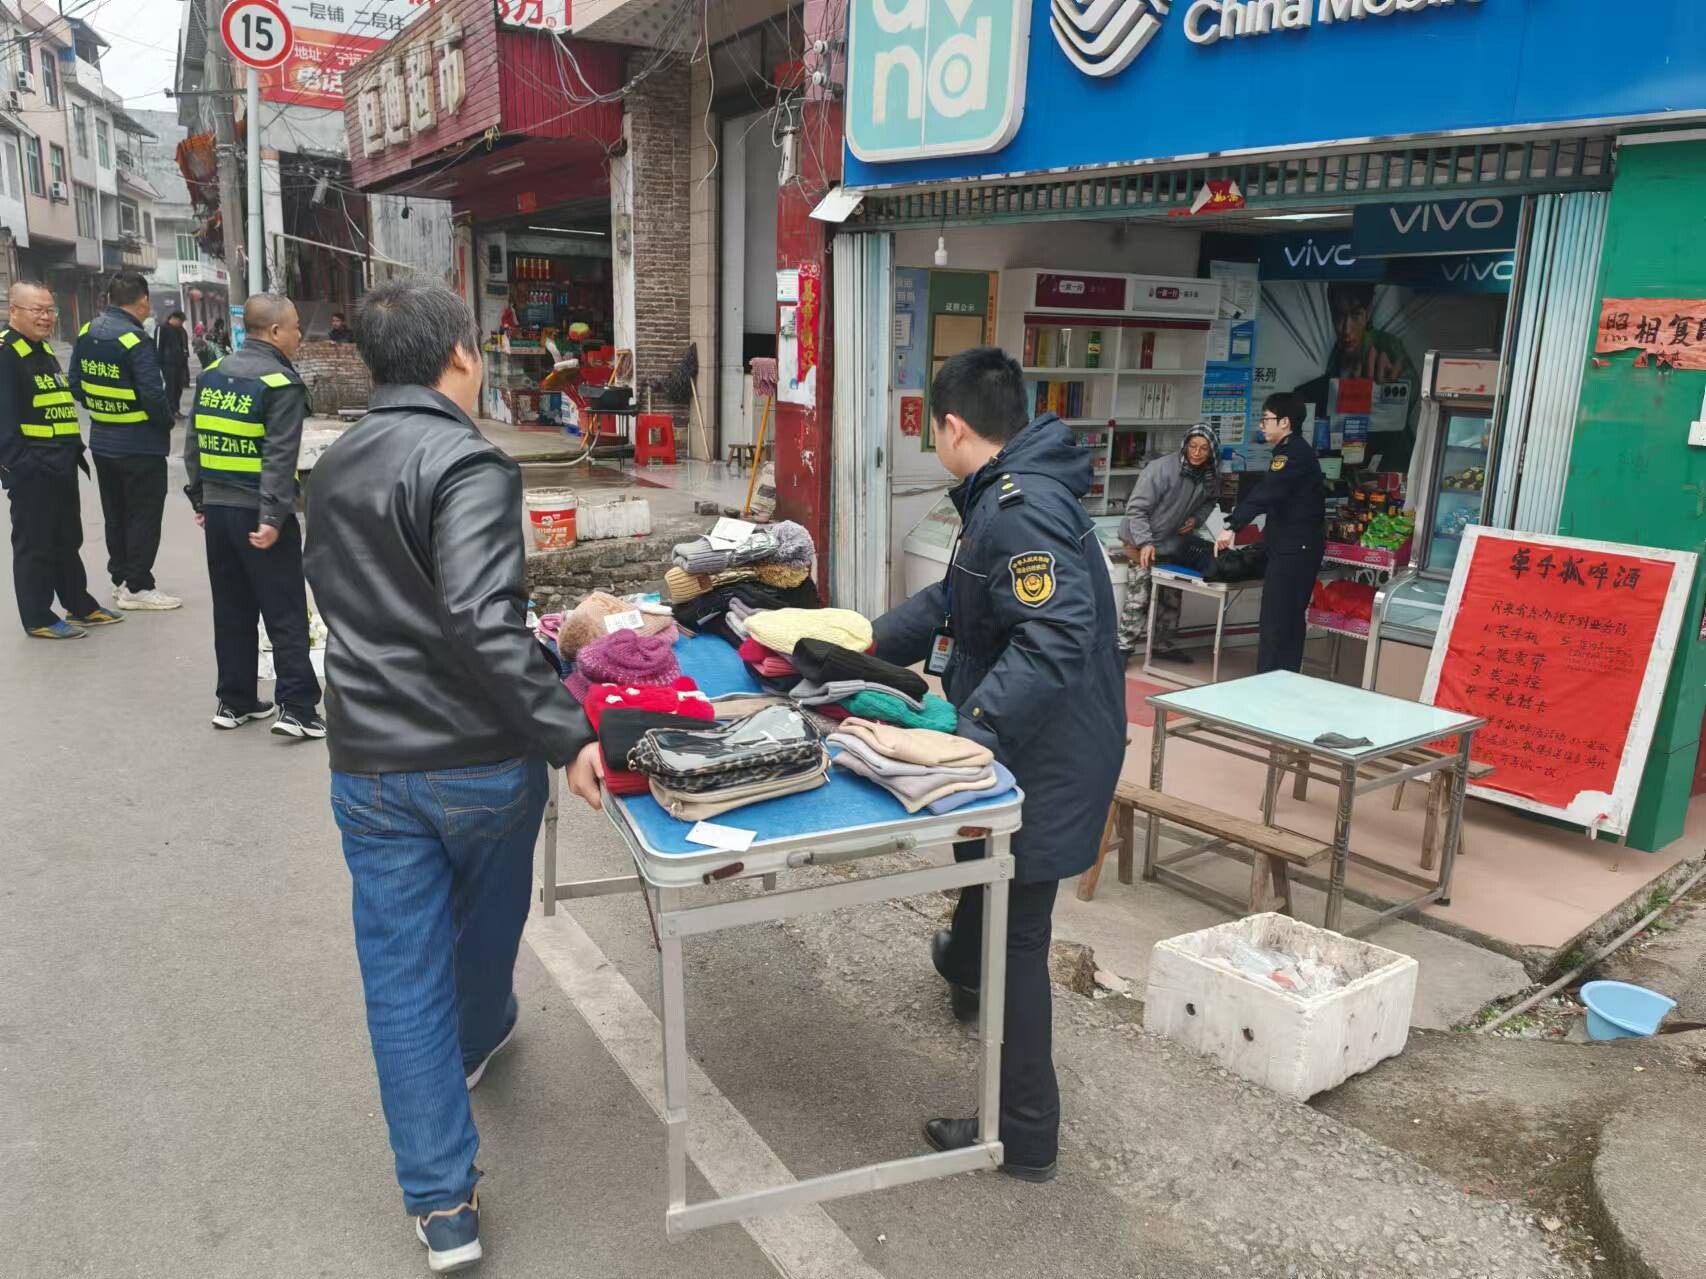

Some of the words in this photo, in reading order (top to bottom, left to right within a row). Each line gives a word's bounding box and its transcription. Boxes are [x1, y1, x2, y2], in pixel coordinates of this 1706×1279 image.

[291, 2, 344, 23] 一层铺
[1184, 0, 1312, 45] China
[241, 14, 273, 51] 15
[1390, 198, 1504, 233] vivo
[1441, 257, 1514, 281] vivo
[81, 359, 120, 379] 综合执法
[1254, 367, 1277, 383] 系列
[200, 387, 253, 414] 综合执法
[208, 435, 220, 451] HE
[220, 436, 239, 453] ZHI
[240, 439, 257, 454] FA
